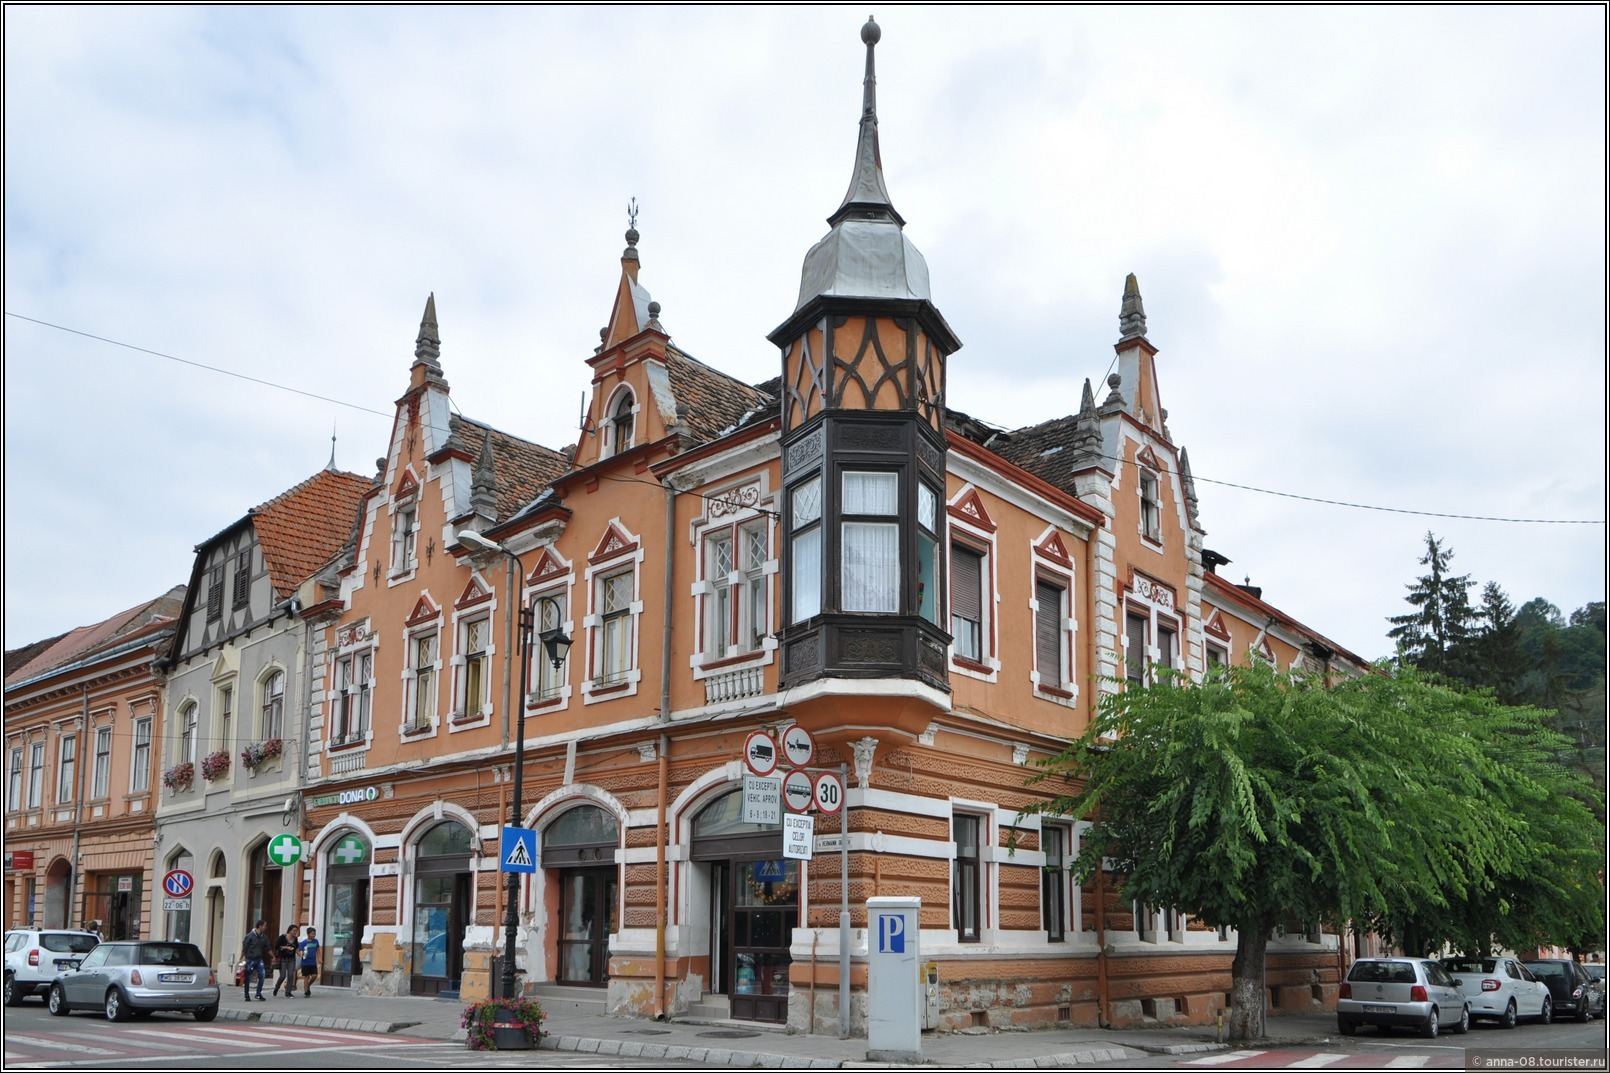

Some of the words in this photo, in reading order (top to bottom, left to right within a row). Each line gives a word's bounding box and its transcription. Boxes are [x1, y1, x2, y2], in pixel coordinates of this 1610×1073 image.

[749, 781, 755, 790] CU
[340, 789, 363, 804] DONA
[820, 783, 837, 804] 30
[787, 818, 792, 828] CU
[792, 831, 805, 842] CELOR
[880, 915, 904, 953] P
